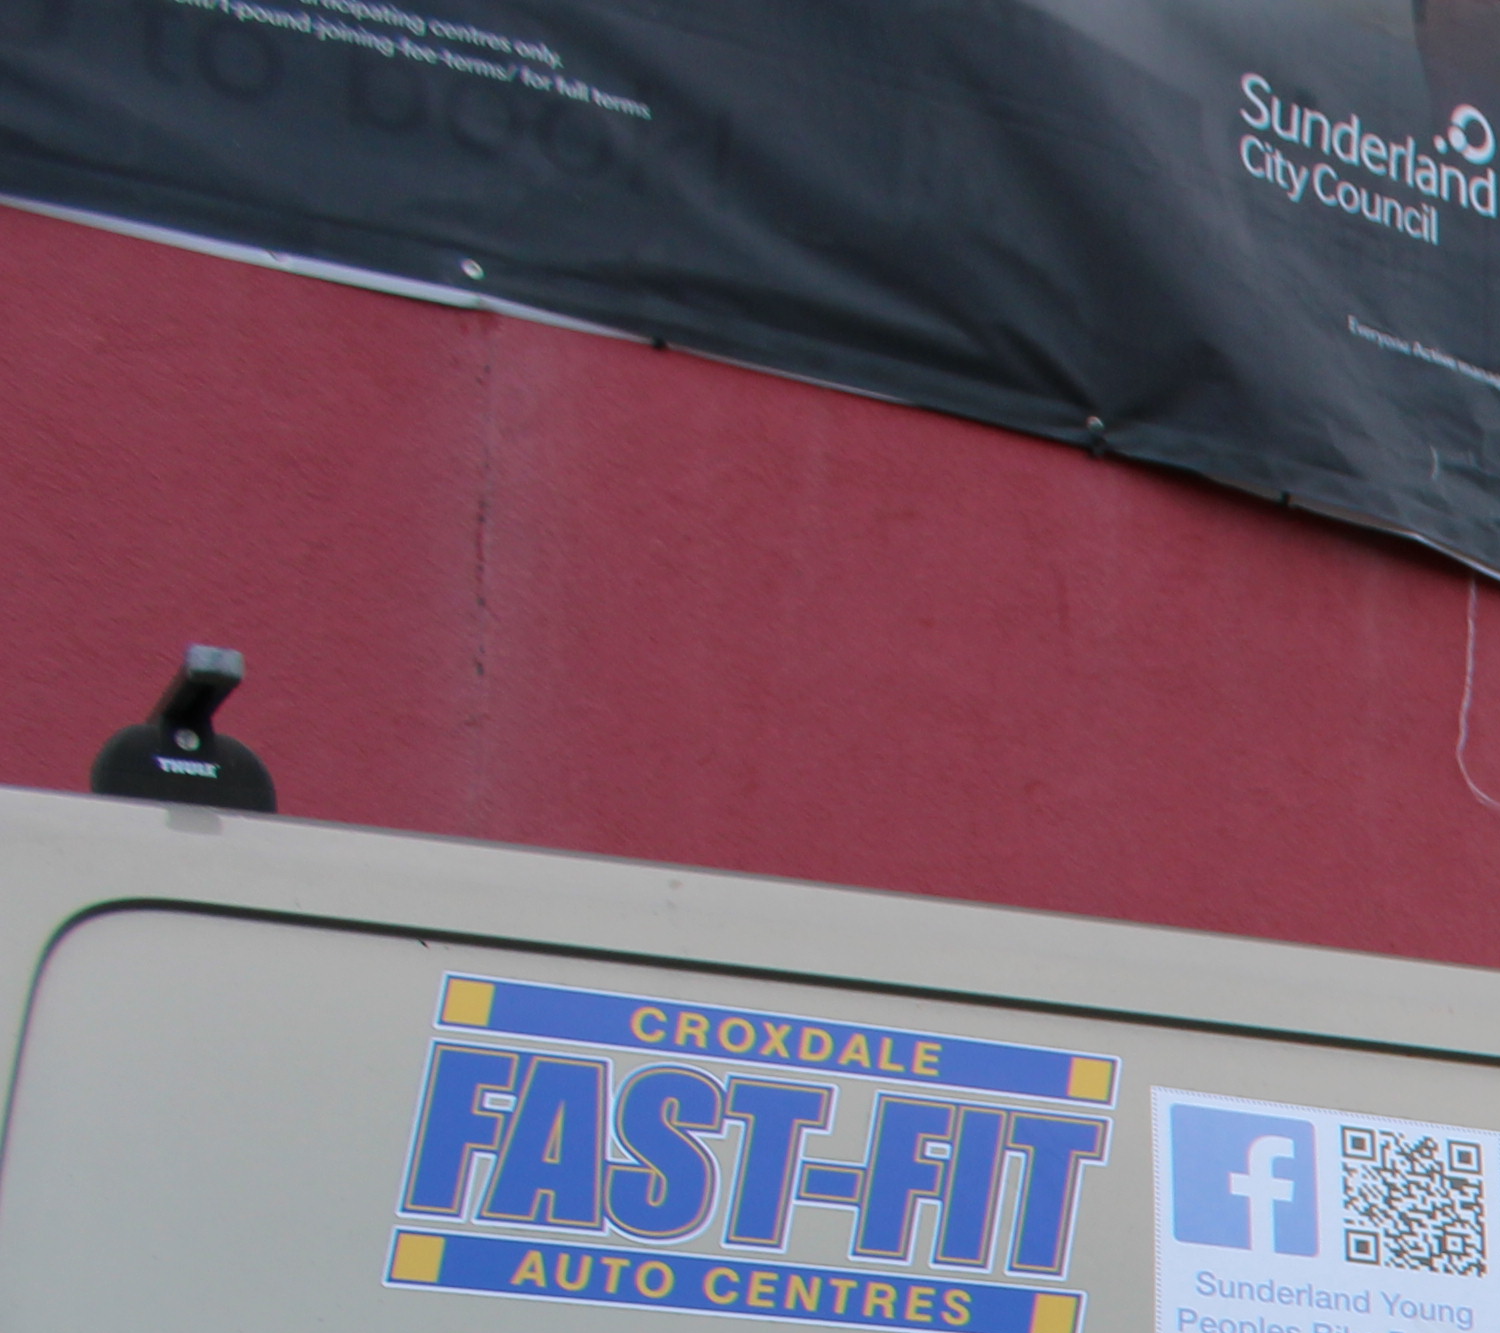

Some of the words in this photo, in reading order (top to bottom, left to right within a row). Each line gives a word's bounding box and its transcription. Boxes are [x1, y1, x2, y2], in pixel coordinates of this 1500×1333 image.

[590, 86, 652, 120] terms
[1240, 73, 1497, 218] Sunderland
[1240, 134, 1308, 203] City
[1312, 163, 1438, 245] Council
[156, 755, 220, 779] THULE
[629, 1007, 942, 1076] CROXDALE
[400, 1037, 1110, 1281] FAST-FIT
[510, 1250, 676, 1298] AUTO
[703, 1268, 973, 1326] CENTRES
[1195, 1270, 1371, 1314] Sunderland
[1381, 1290, 1474, 1330] Young
